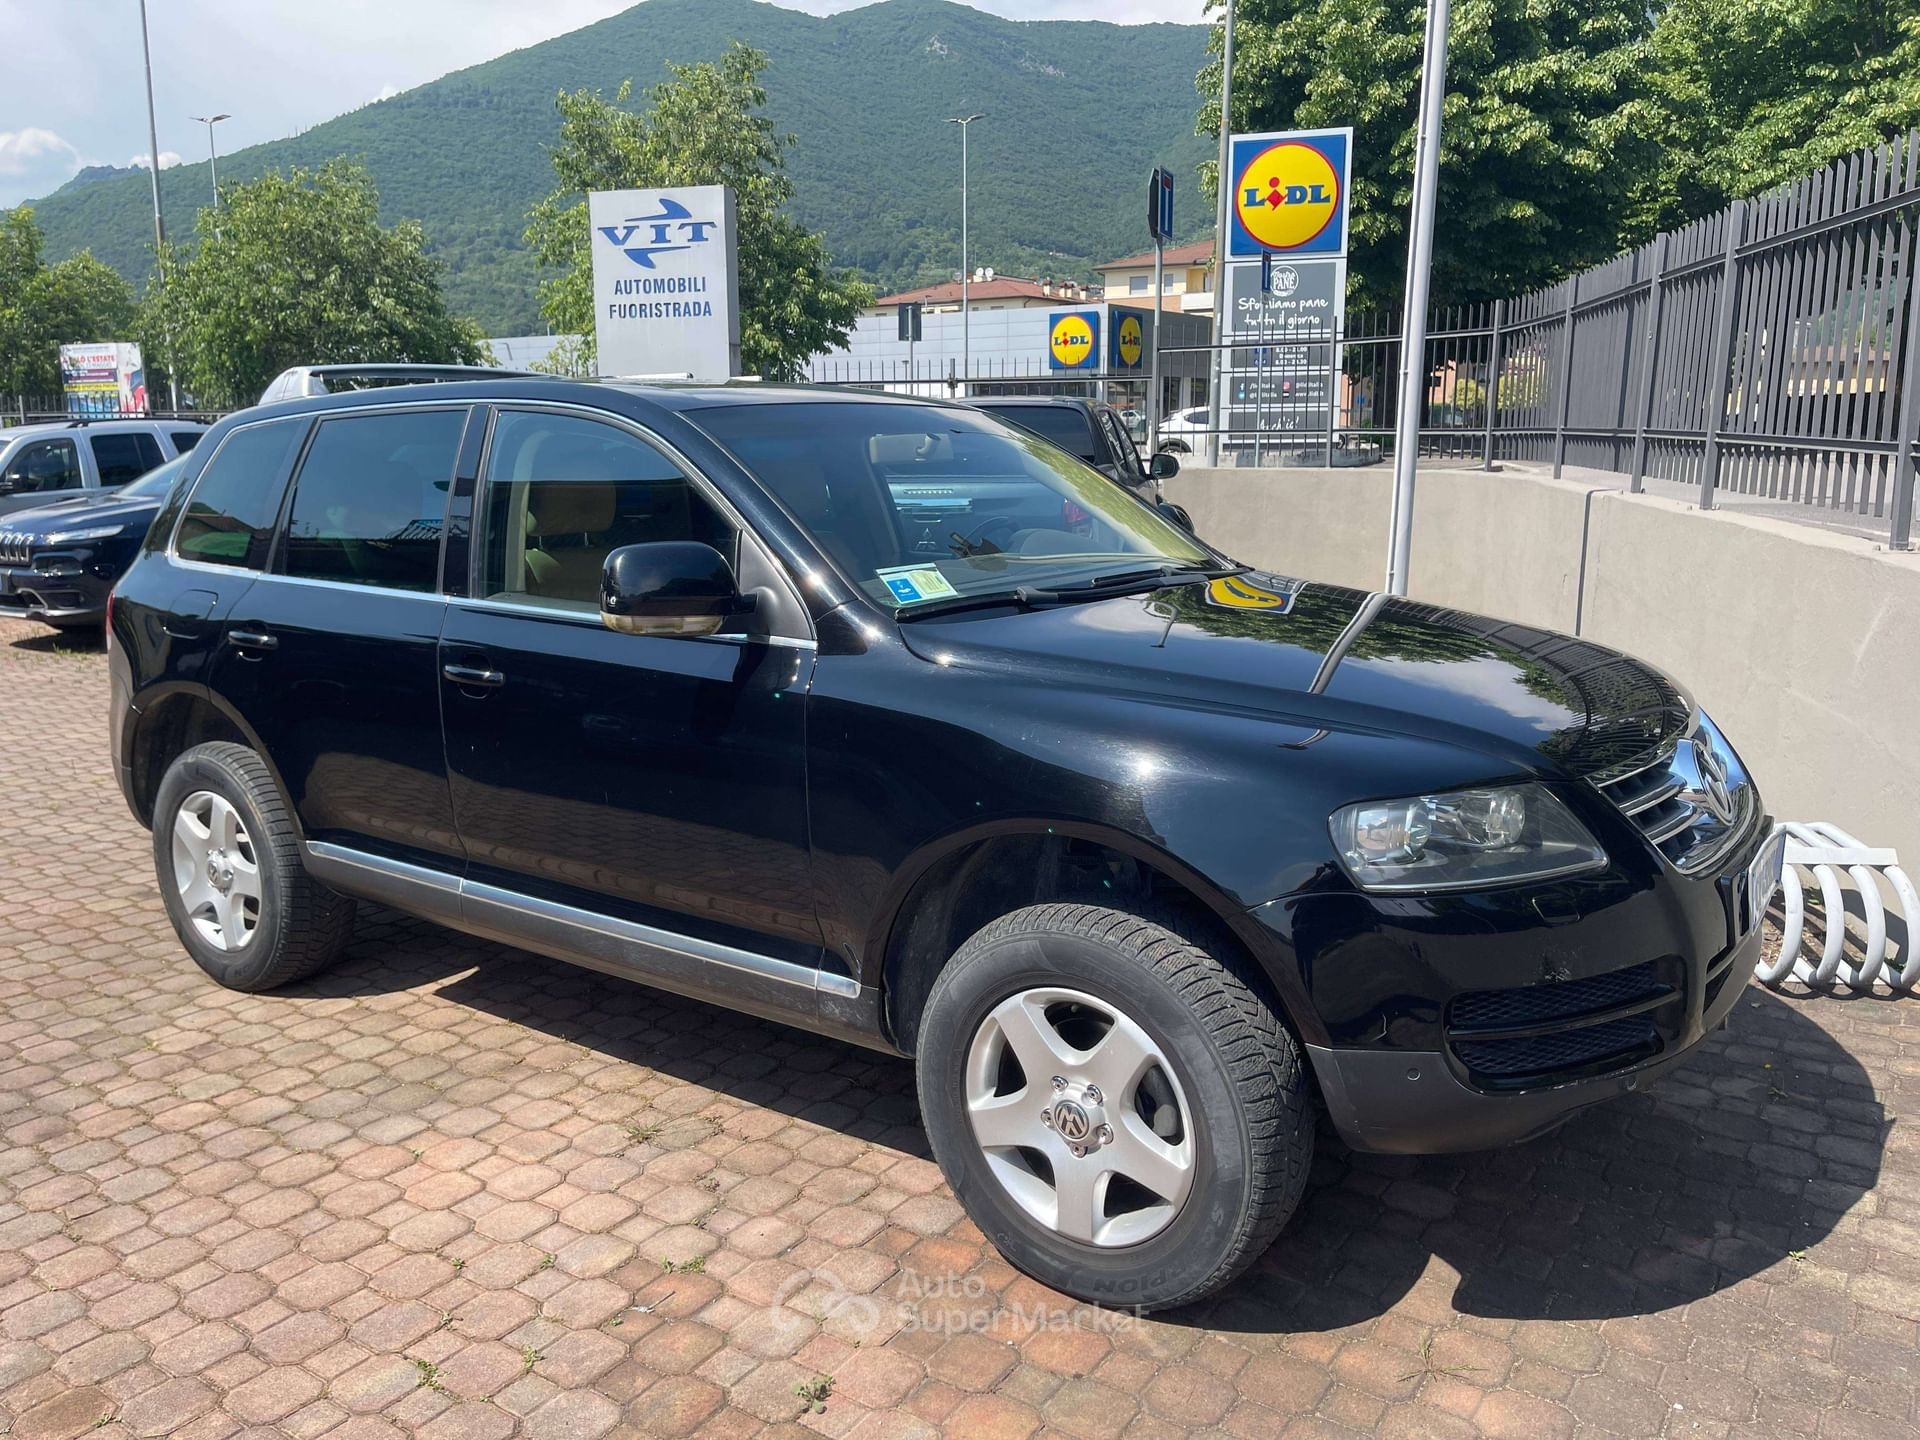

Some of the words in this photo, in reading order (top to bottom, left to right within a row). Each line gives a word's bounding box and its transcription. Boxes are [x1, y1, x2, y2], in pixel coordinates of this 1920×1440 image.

[597, 221, 718, 246] VIT
[614, 276, 706, 295] AUTOMOBILI
[1273, 277, 1295, 290] PANE
[609, 301, 713, 319] FUORISTRADA
[1238, 297, 1297, 311] Sfoniamo
[1299, 298, 1329, 312] pane
[1278, 310, 1285, 325] il
[1287, 313, 1320, 329] giorno
[87, 354, 115, 363] L'ESTATE
